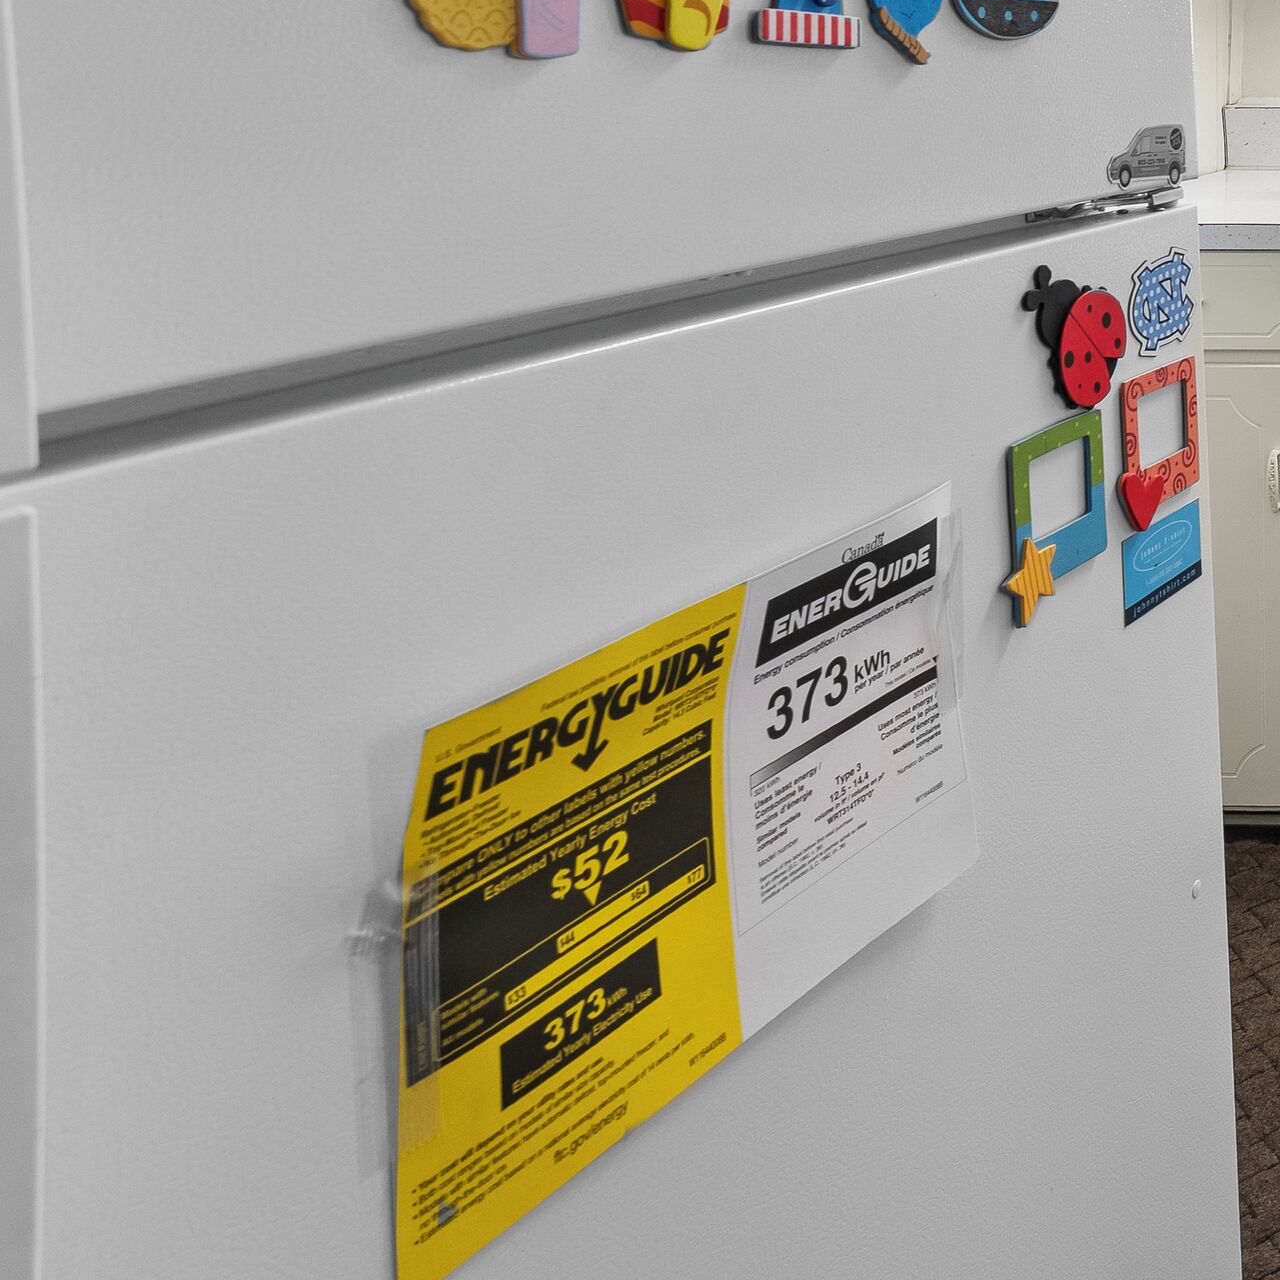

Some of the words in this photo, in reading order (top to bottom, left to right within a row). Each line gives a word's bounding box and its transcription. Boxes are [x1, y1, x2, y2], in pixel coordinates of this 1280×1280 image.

[841, 534, 885, 564] Canada
[770, 543, 931, 644] ENERGUIDE
[1133, 568, 1197, 619] johnnytshirt.com
[753, 661, 782, 686] Energy
[784, 634, 834, 669] consumption
[840, 603, 893, 639] Consommation
[854, 679, 866, 693] per
[868, 669, 883, 685] year
[890, 659, 902, 672] par
[903, 645, 924, 664] année
[767, 655, 849, 740] 373
[854, 649, 891, 683] kWh
[878, 716, 893, 732] Uses
[894, 705, 910, 722] most
[912, 692, 933, 713] energy
[424, 627, 732, 822] ENERGYGUIDE
[880, 713, 916, 742] Consomme
[924, 700, 938, 716] plus
[476, 832, 513, 864] ONLY
[514, 825, 528, 843] to
[530, 805, 562, 834] other
[563, 786, 597, 815] labels
[599, 771, 622, 794] with
[624, 751, 658, 784] yellow
[659, 725, 705, 761] numbers.
[754, 792, 772, 810] Uses
[774, 780, 792, 797] least
[793, 765, 817, 787] energy
[829, 785, 846, 803] 12.5
[853, 770, 868, 788] 14.4
[835, 765, 854, 788] Type
[755, 787, 796, 820] Consomme
[484, 853, 546, 902] Estimated
[549, 830, 587, 867] Yearly
[589, 806, 628, 844] Energy
[631, 790, 656, 817] Cost
[551, 830, 630, 901] $52
[631, 883, 646, 902] $64
[512, 1048, 561, 1096] Estimated
[563, 1028, 591, 1061] Yearly
[592, 997, 634, 1039] Electricity
[635, 983, 652, 1006] Use
[544, 987, 607, 1050] 373
